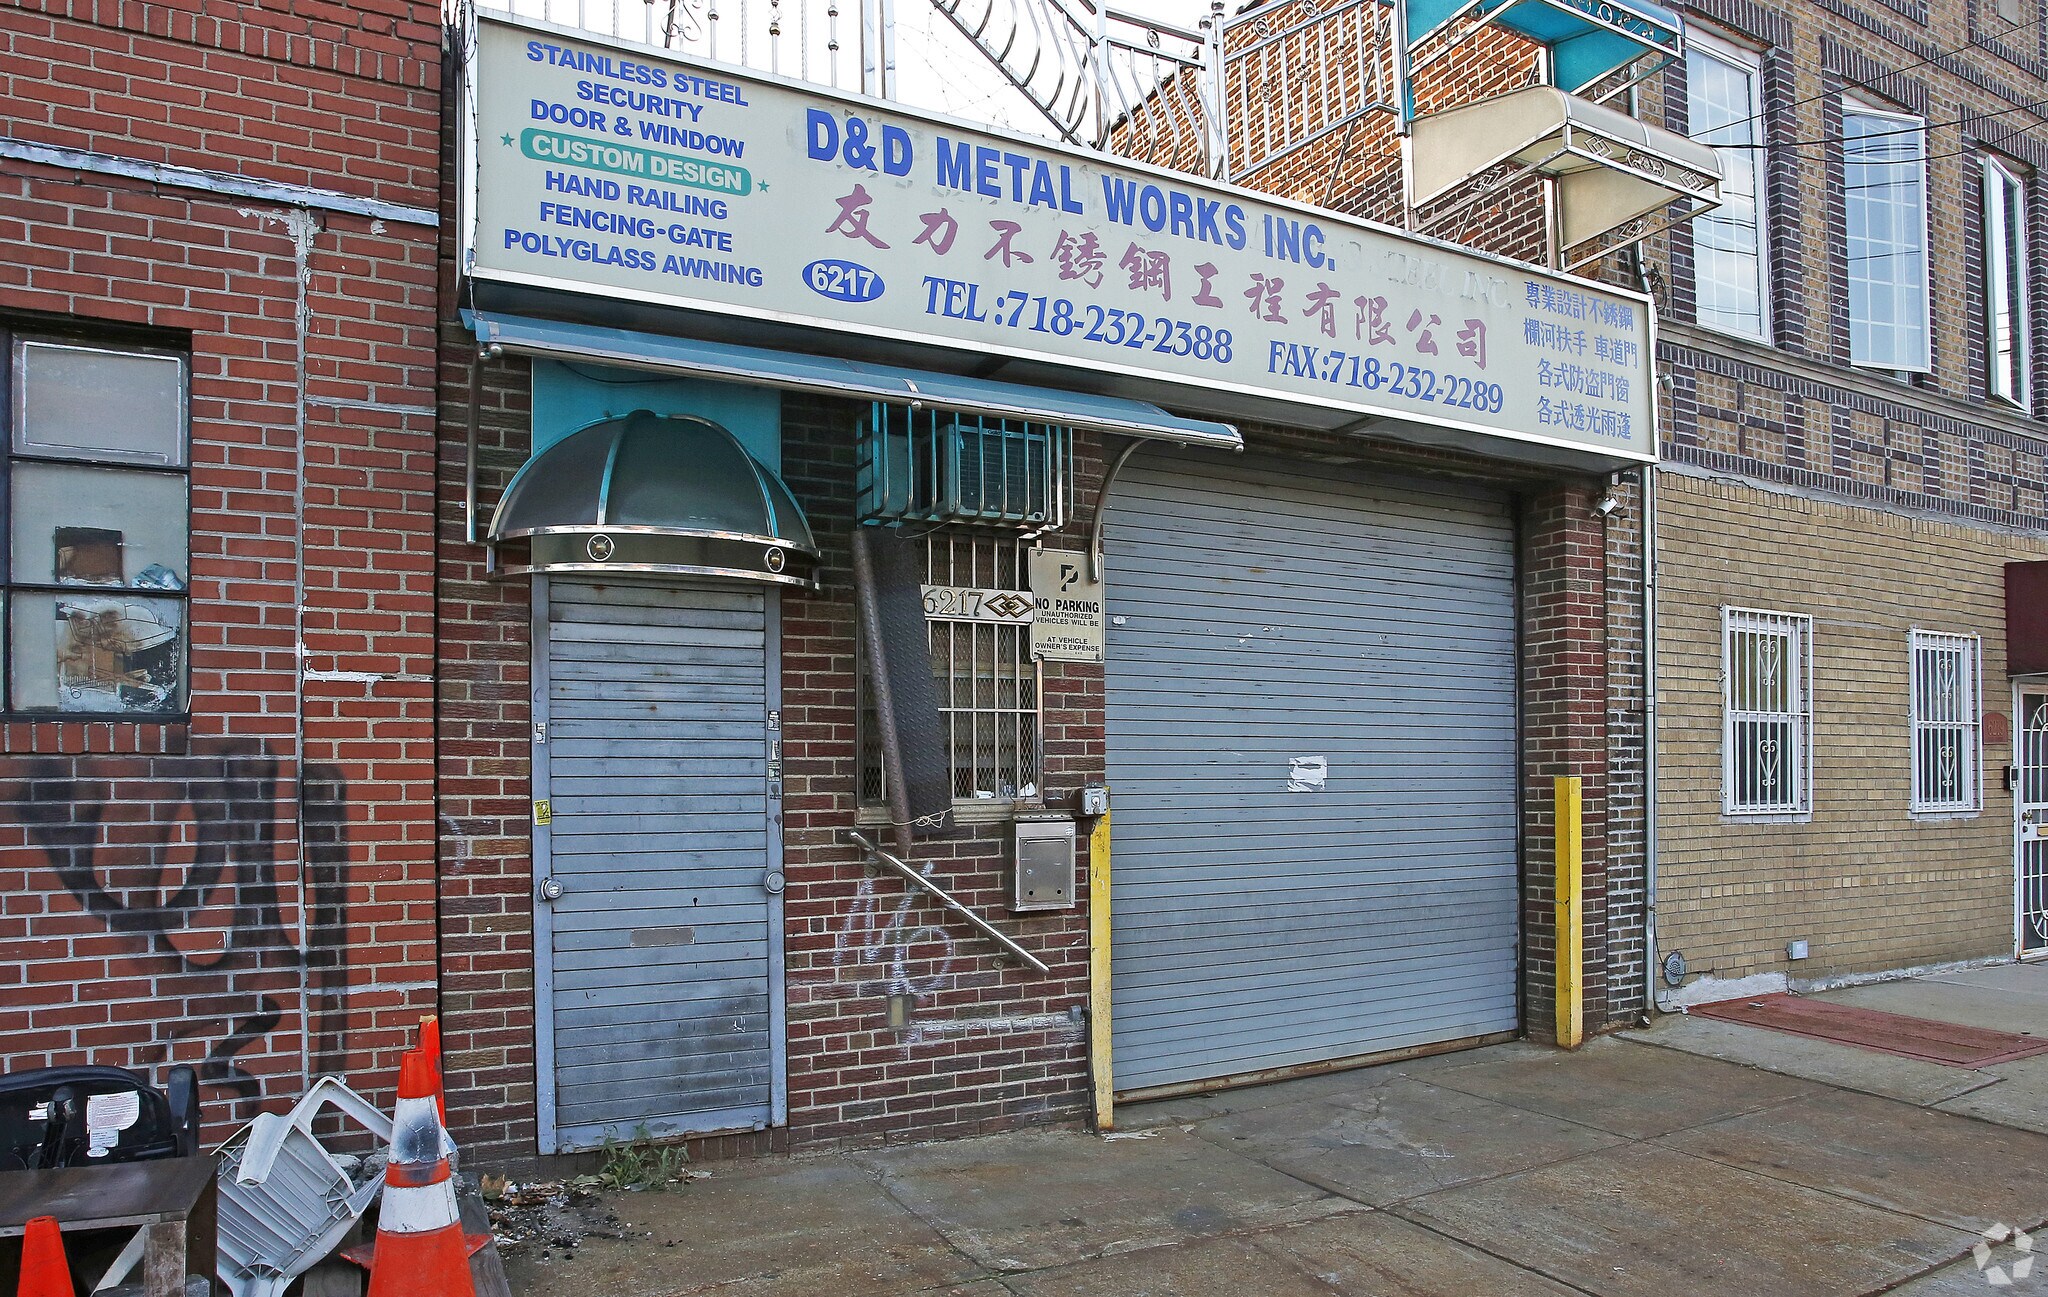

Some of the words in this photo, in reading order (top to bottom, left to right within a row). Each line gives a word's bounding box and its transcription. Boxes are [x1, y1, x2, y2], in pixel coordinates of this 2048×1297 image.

[527, 41, 667, 88] STAINLESS
[673, 73, 749, 107] STEEL
[576, 80, 704, 123] SECURITY
[531, 99, 606, 132] DOOR
[613, 116, 633, 137] &
[639, 120, 745, 159] WINDOW
[531, 134, 645, 174] CUSTOM
[650, 156, 742, 191] DESIGN
[545, 170, 620, 201] HAND
[627, 185, 728, 220] RAILING
[806, 108, 914, 177] D&D
[936, 137, 1084, 215] METAL
[1101, 175, 1248, 251] WORKS
[1264, 214, 1336, 271] INC.
[504, 229, 657, 271] POLYGLASS
[662, 255, 763, 287] AWNING
[810, 262, 876, 299] 6217
[922, 588, 984, 617] 6217
[1035, 598, 1049, 610] NO
[1056, 599, 1099, 613] PARKING
[1035, 616, 1069, 625] VEHICLES
[1041, 610, 1093, 620] UNAUTHORIZED
[1035, 642, 1067, 650] OWNER'S
[1068, 643, 1099, 652] EXPENSE
[1058, 637, 1088, 645] VEHICLE
